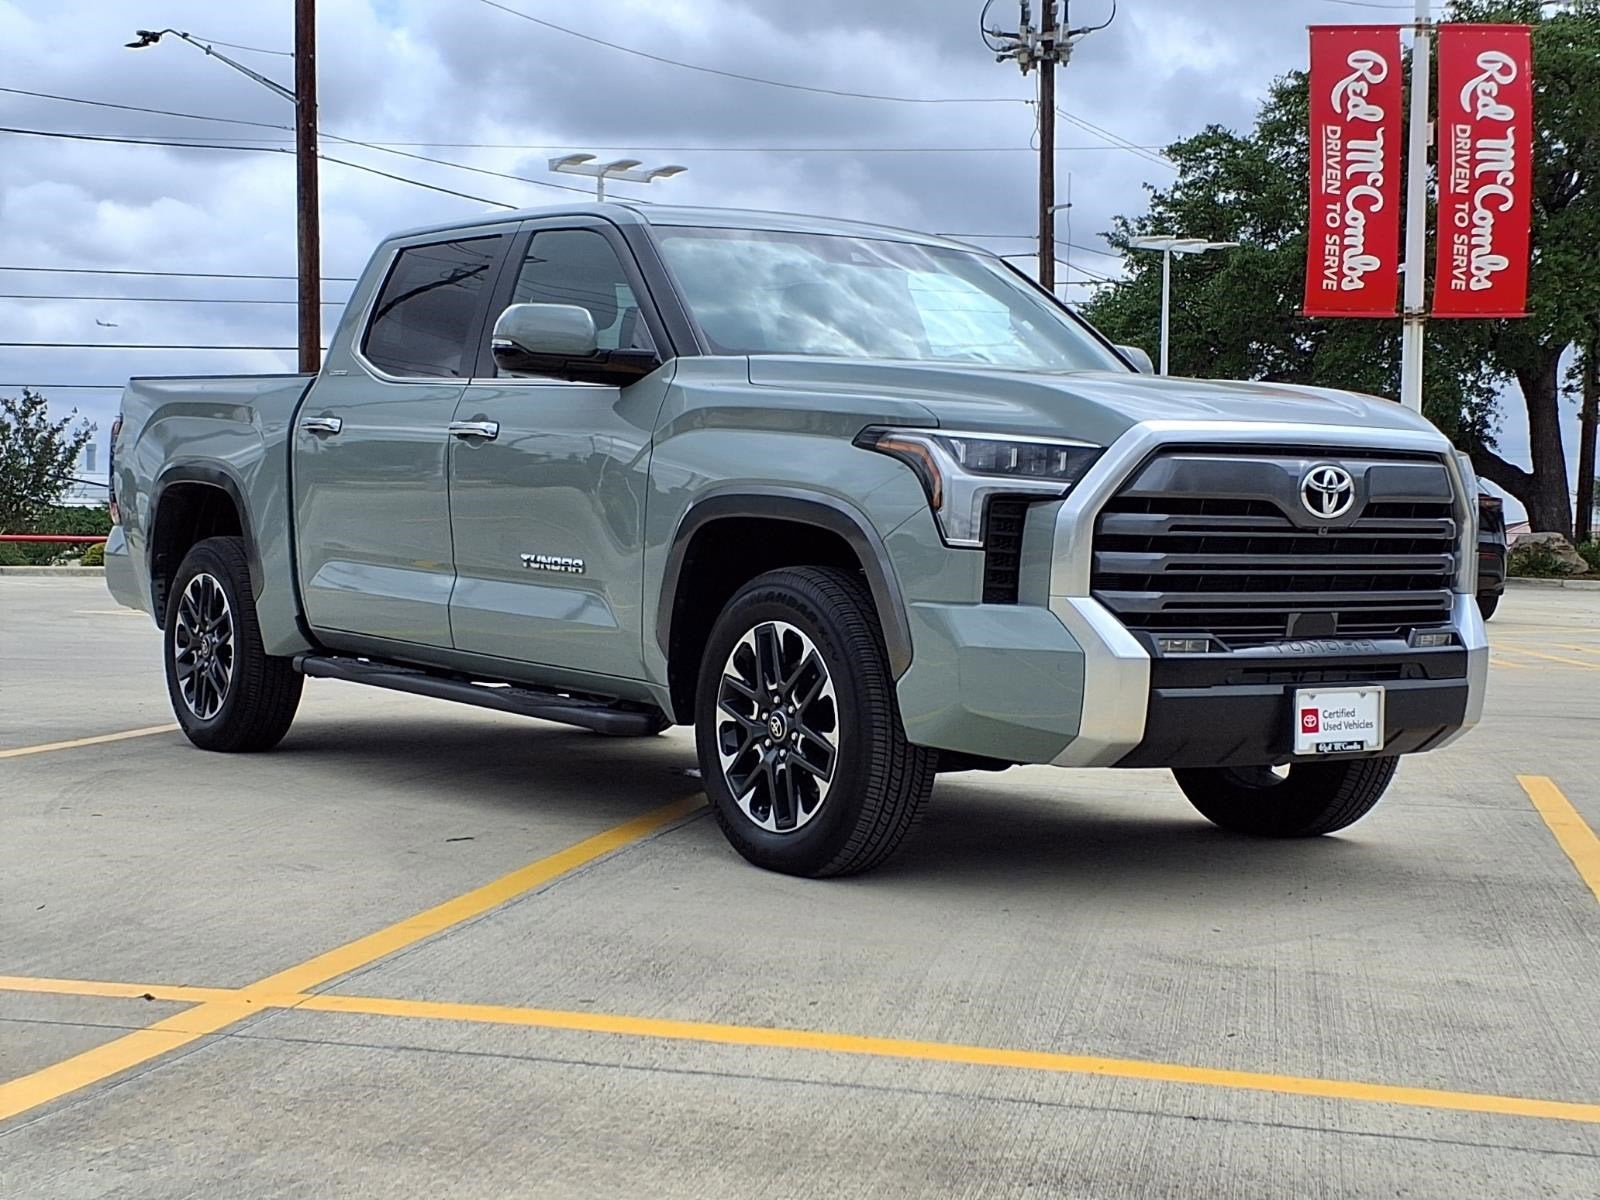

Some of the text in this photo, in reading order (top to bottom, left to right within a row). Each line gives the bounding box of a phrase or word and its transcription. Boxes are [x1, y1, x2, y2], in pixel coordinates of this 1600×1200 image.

[1321, 125, 1342, 291] DRIVEN TO SERVE
[1331, 49, 1388, 291] Red McCombs
[1450, 124, 1471, 291] DRIVEN TO SERVE
[1460, 50, 1518, 290] Red McCombs
[520, 553, 584, 573] TUNDRA
[1322, 708, 1356, 719] Certified
[1322, 719, 1374, 732] Used Vehicles
